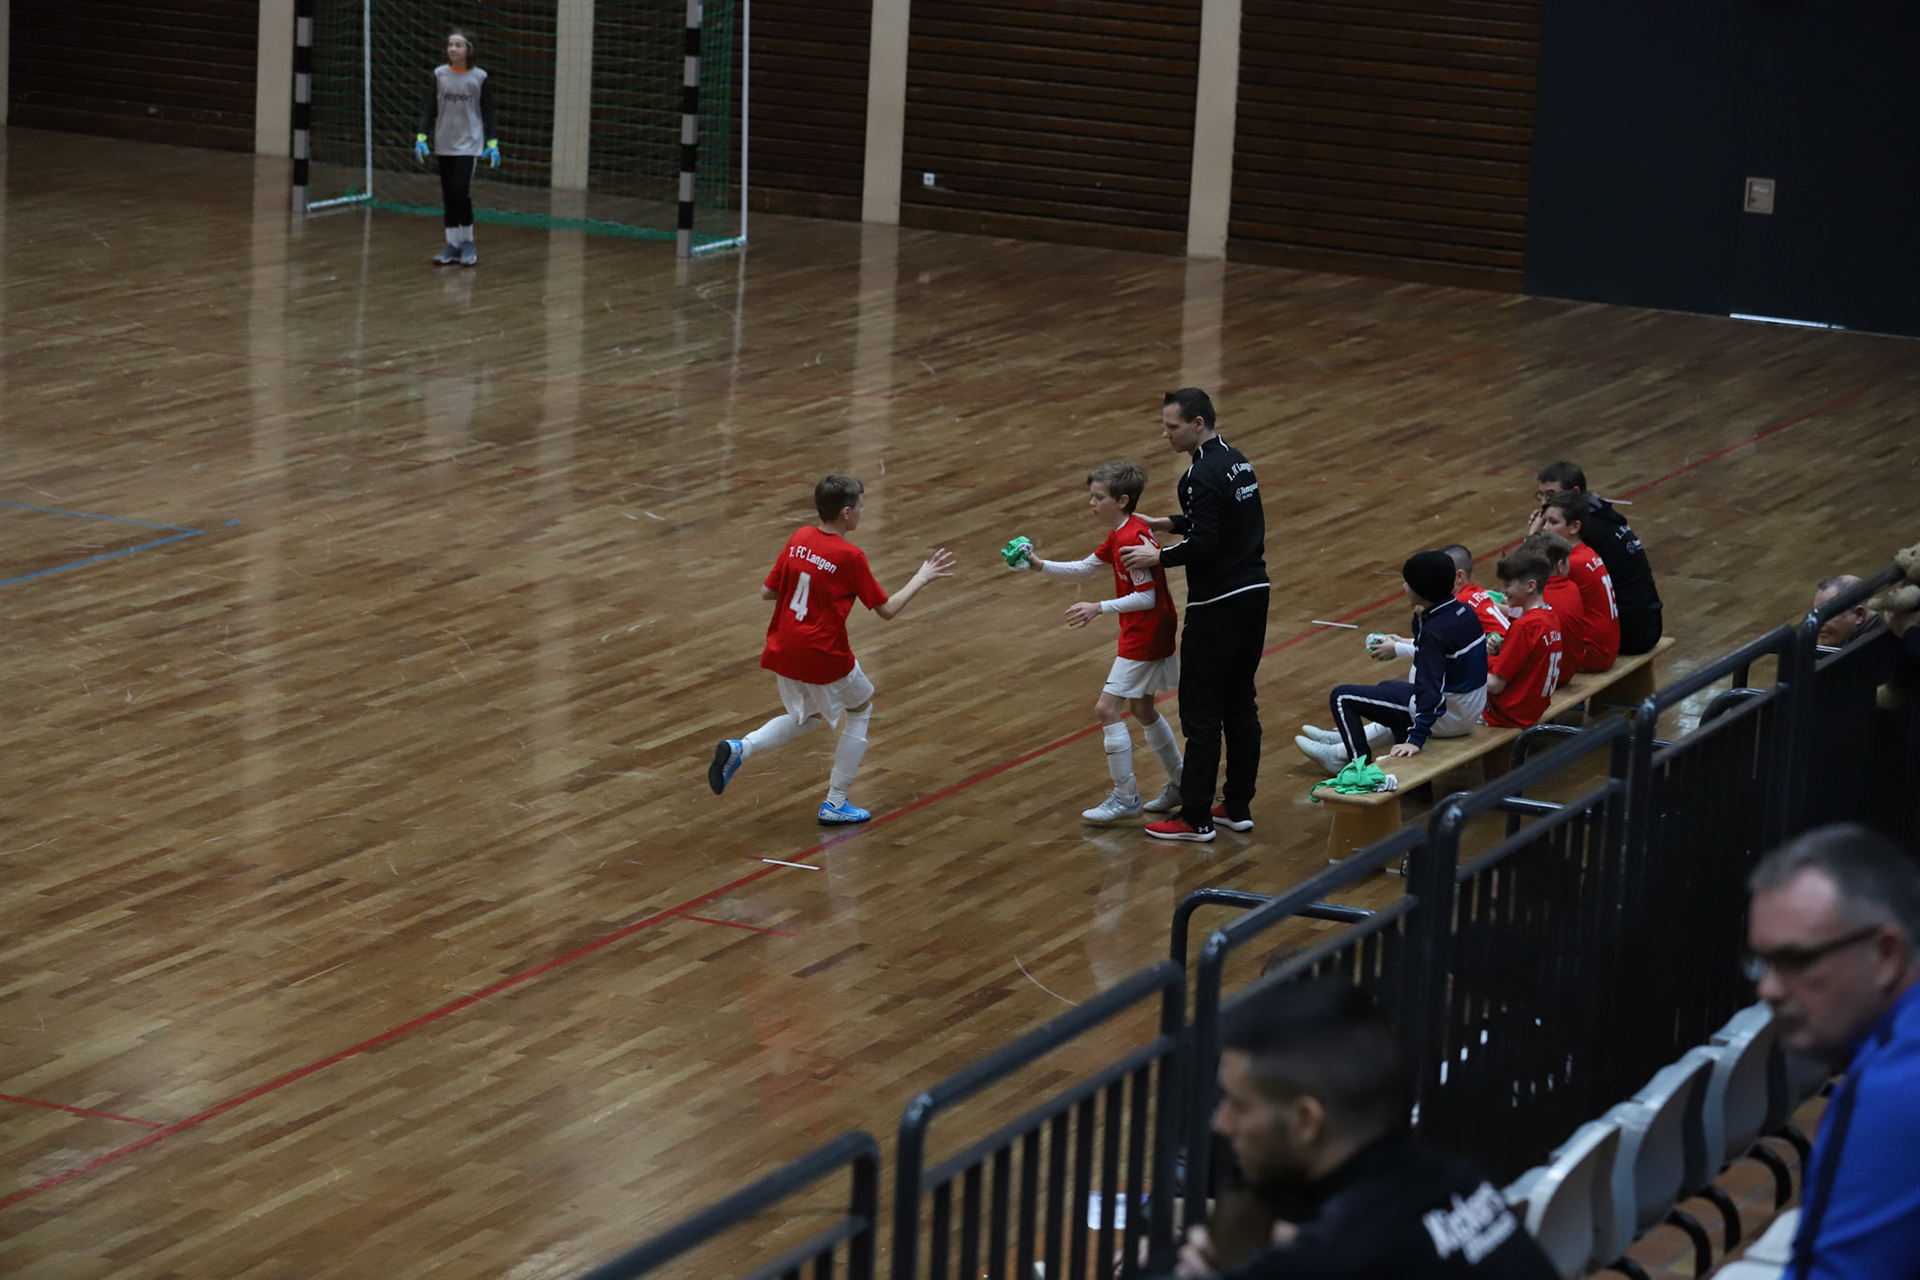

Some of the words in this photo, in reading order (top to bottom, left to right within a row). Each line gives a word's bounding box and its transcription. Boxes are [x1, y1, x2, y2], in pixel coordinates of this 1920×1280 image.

[788, 546, 795, 558] 1.
[795, 545, 807, 559] FC
[806, 550, 837, 574] Langen
[789, 571, 811, 622] 4
[1541, 651, 1563, 697] 15
